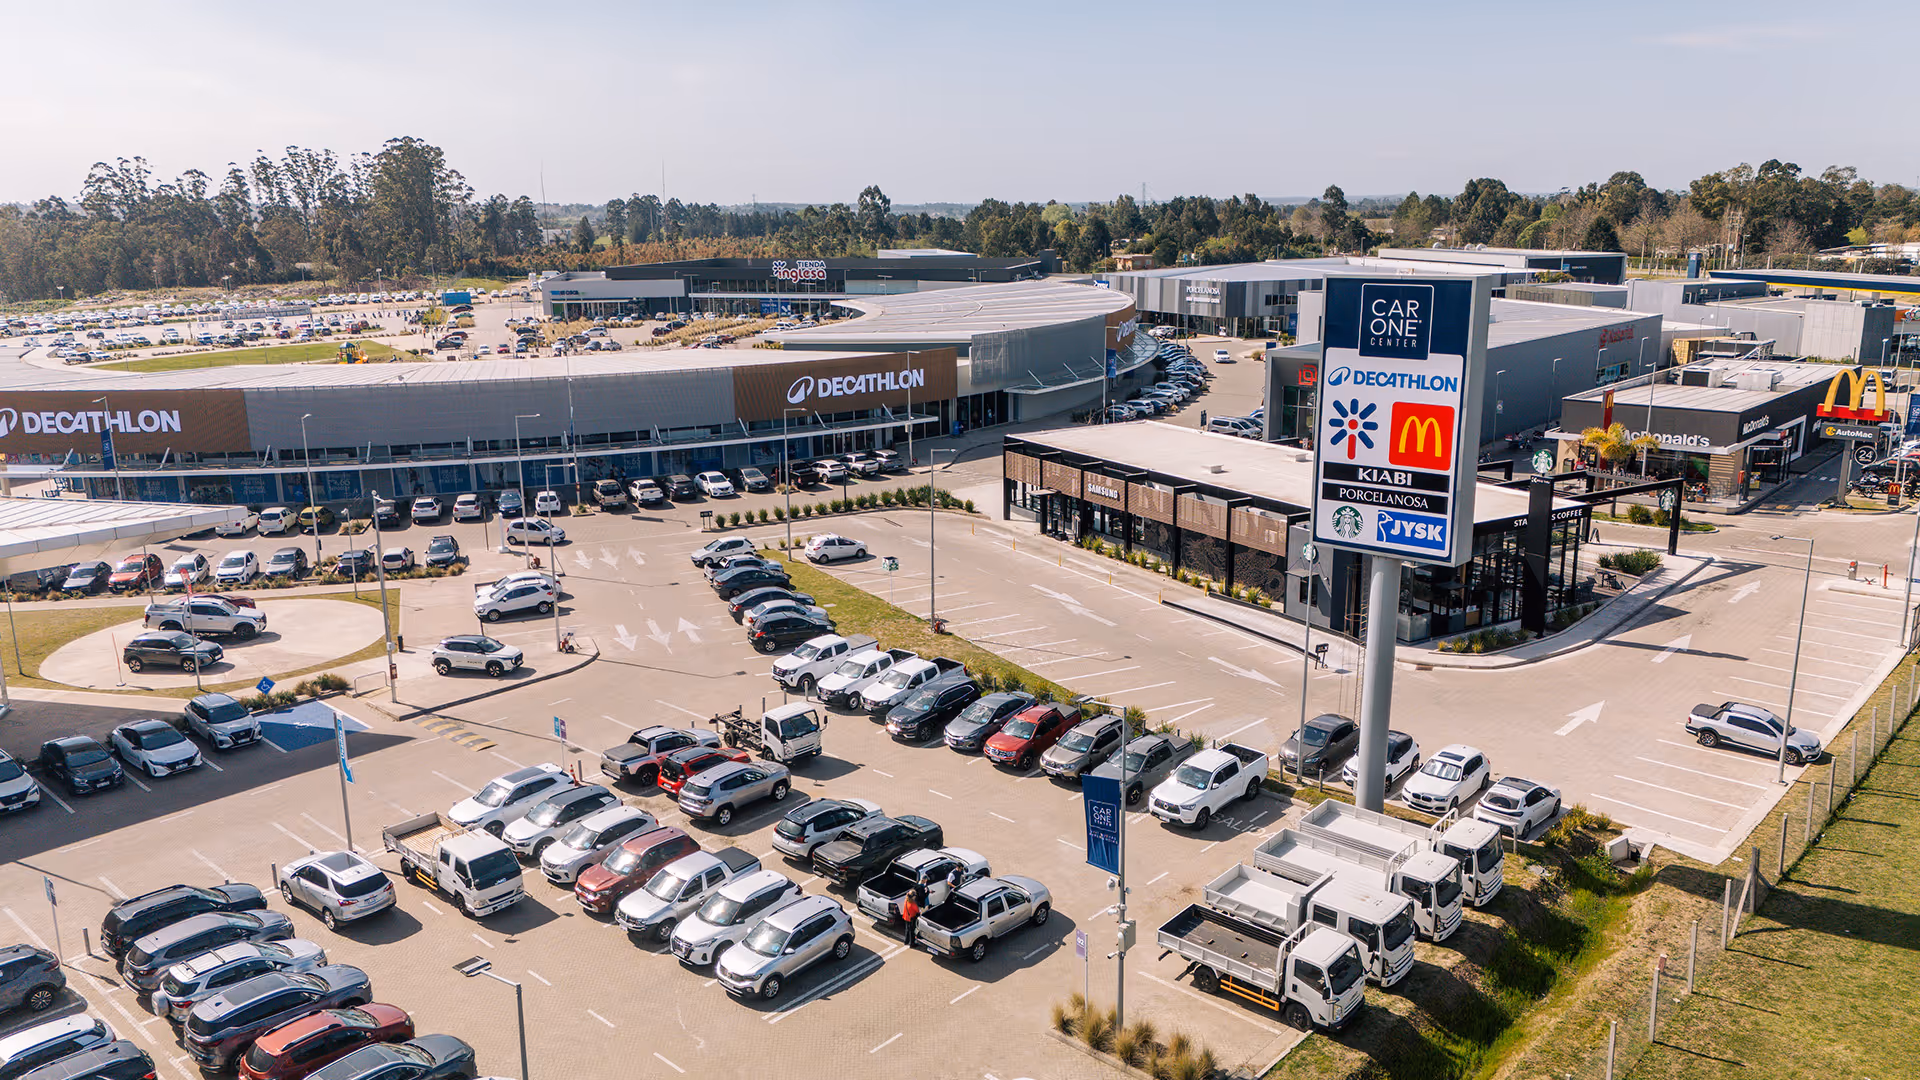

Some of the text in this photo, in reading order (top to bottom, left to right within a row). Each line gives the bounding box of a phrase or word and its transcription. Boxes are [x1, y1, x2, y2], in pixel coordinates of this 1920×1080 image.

[796, 260, 826, 269] TIENDA
[778, 268, 826, 283] inglesa
[1371, 299, 1419, 318] CAR
[1370, 318, 1418, 337] ONE
[1370, 337, 1417, 348] CENTER
[818, 368, 925, 398] DECATHLON
[1353, 370, 1458, 392] DECATHLON
[22, 410, 182, 434] DECATHLON
[1836, 429, 1874, 439] AutoMac
[1858, 449, 1873, 460] 24
[1358, 467, 1412, 486] KIABI
[1088, 483, 1118, 499] SAMSUNG
[1339, 487, 1428, 509] PORCELANOSA
[1556, 508, 1583, 520] COFFEE
[1390, 519, 1443, 542] JYSK
[1093, 806, 1112, 815] CAR
[1093, 812, 1112, 823] ONE
